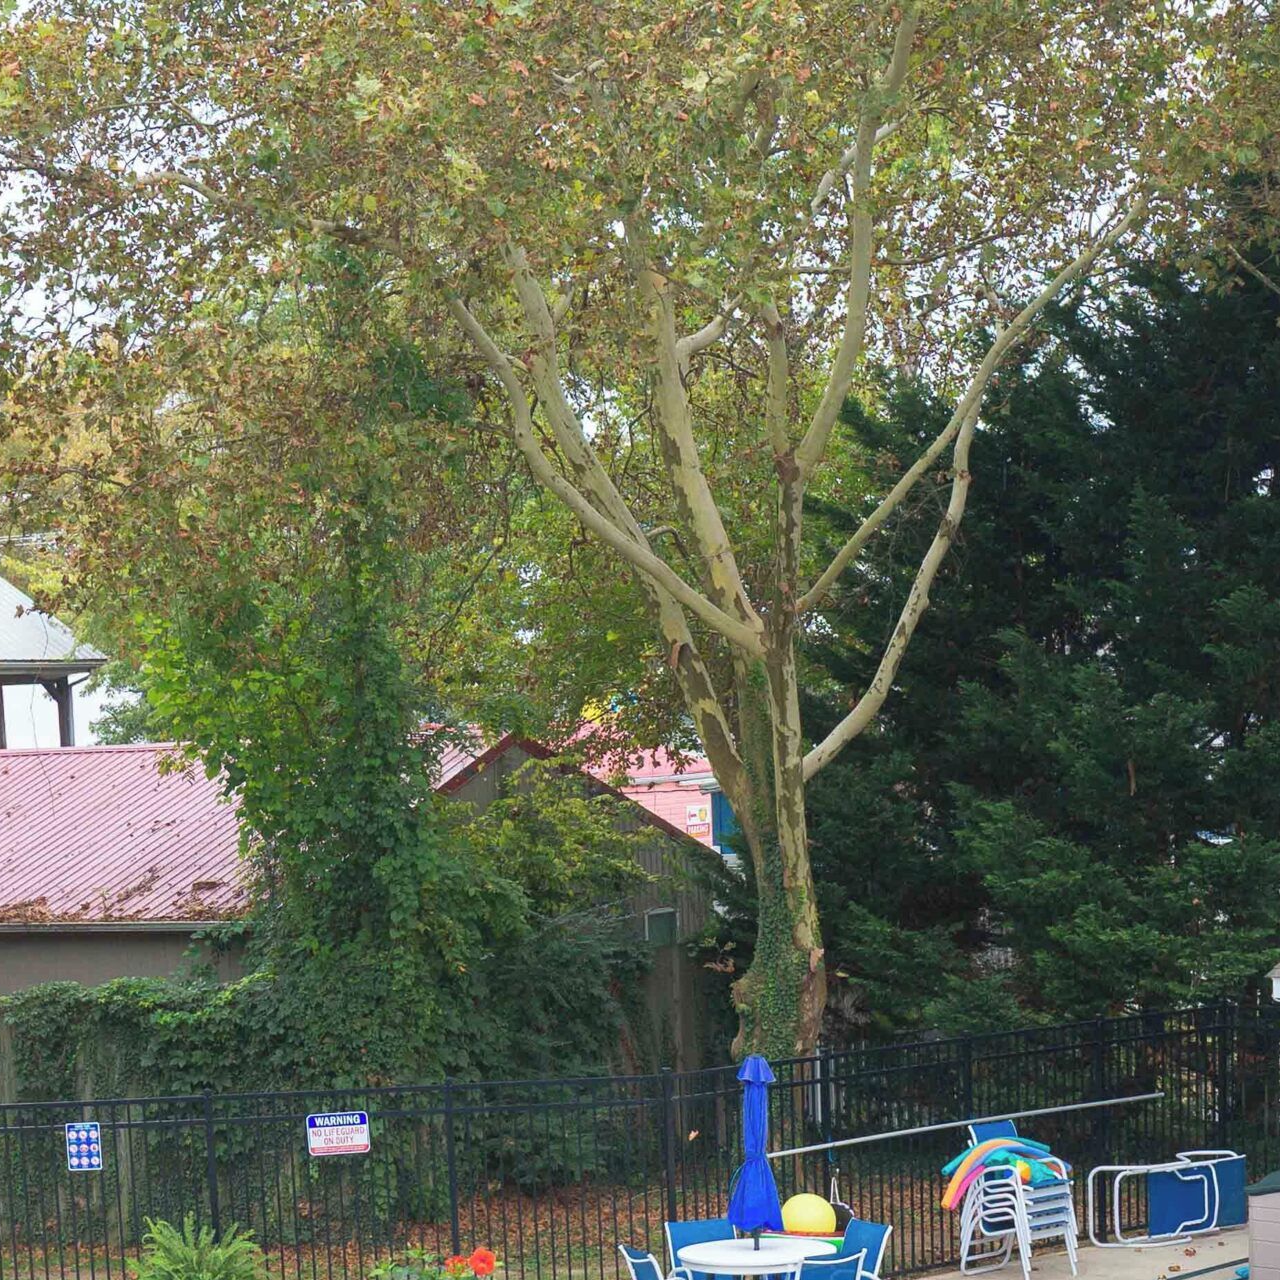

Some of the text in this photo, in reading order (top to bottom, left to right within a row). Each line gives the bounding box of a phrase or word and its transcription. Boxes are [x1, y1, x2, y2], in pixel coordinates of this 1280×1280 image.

[314, 1114, 360, 1126] WARNING
[312, 1127, 364, 1137] NO LIFEGUARD
[324, 1136, 353, 1145] ON DUTY
